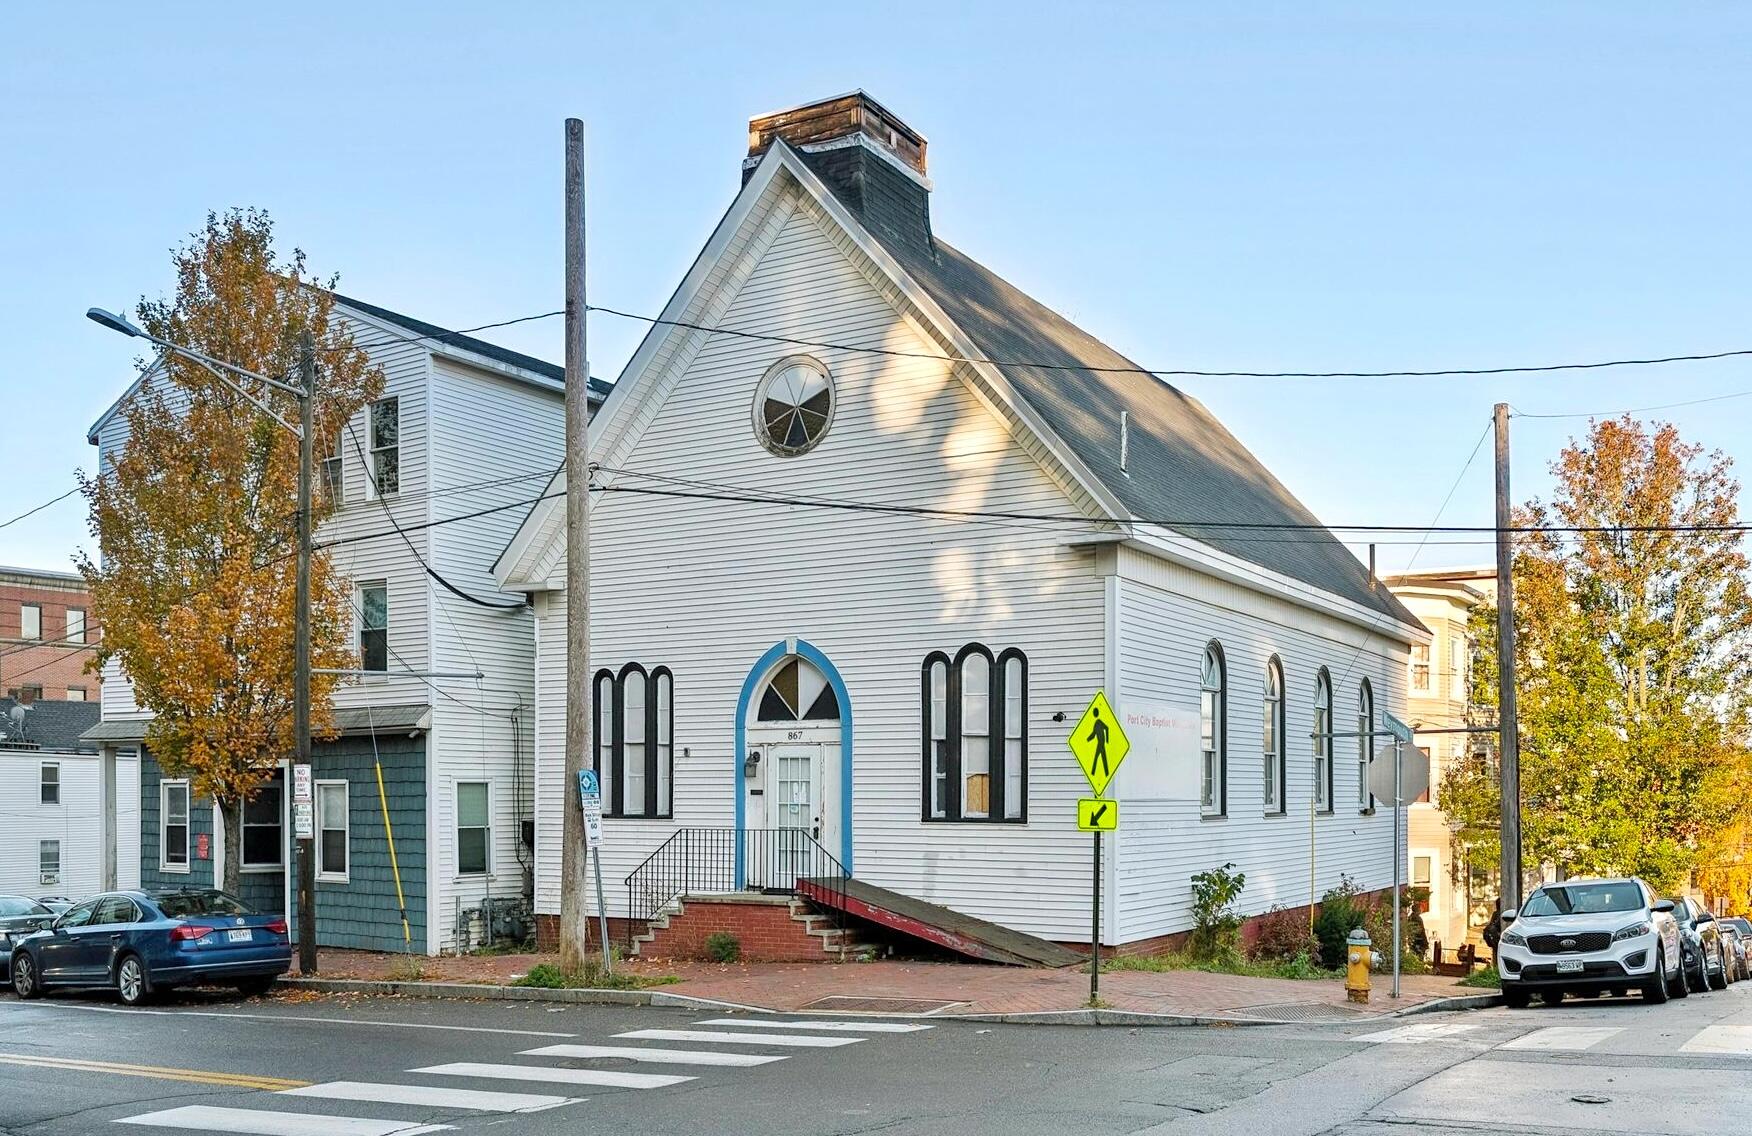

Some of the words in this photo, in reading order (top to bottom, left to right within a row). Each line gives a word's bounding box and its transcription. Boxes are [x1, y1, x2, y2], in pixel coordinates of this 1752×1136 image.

[1127, 713, 1139, 725] Port
[1140, 714, 1151, 728] City
[1152, 716, 1171, 728] Baptist
[788, 731, 803, 740] 867
